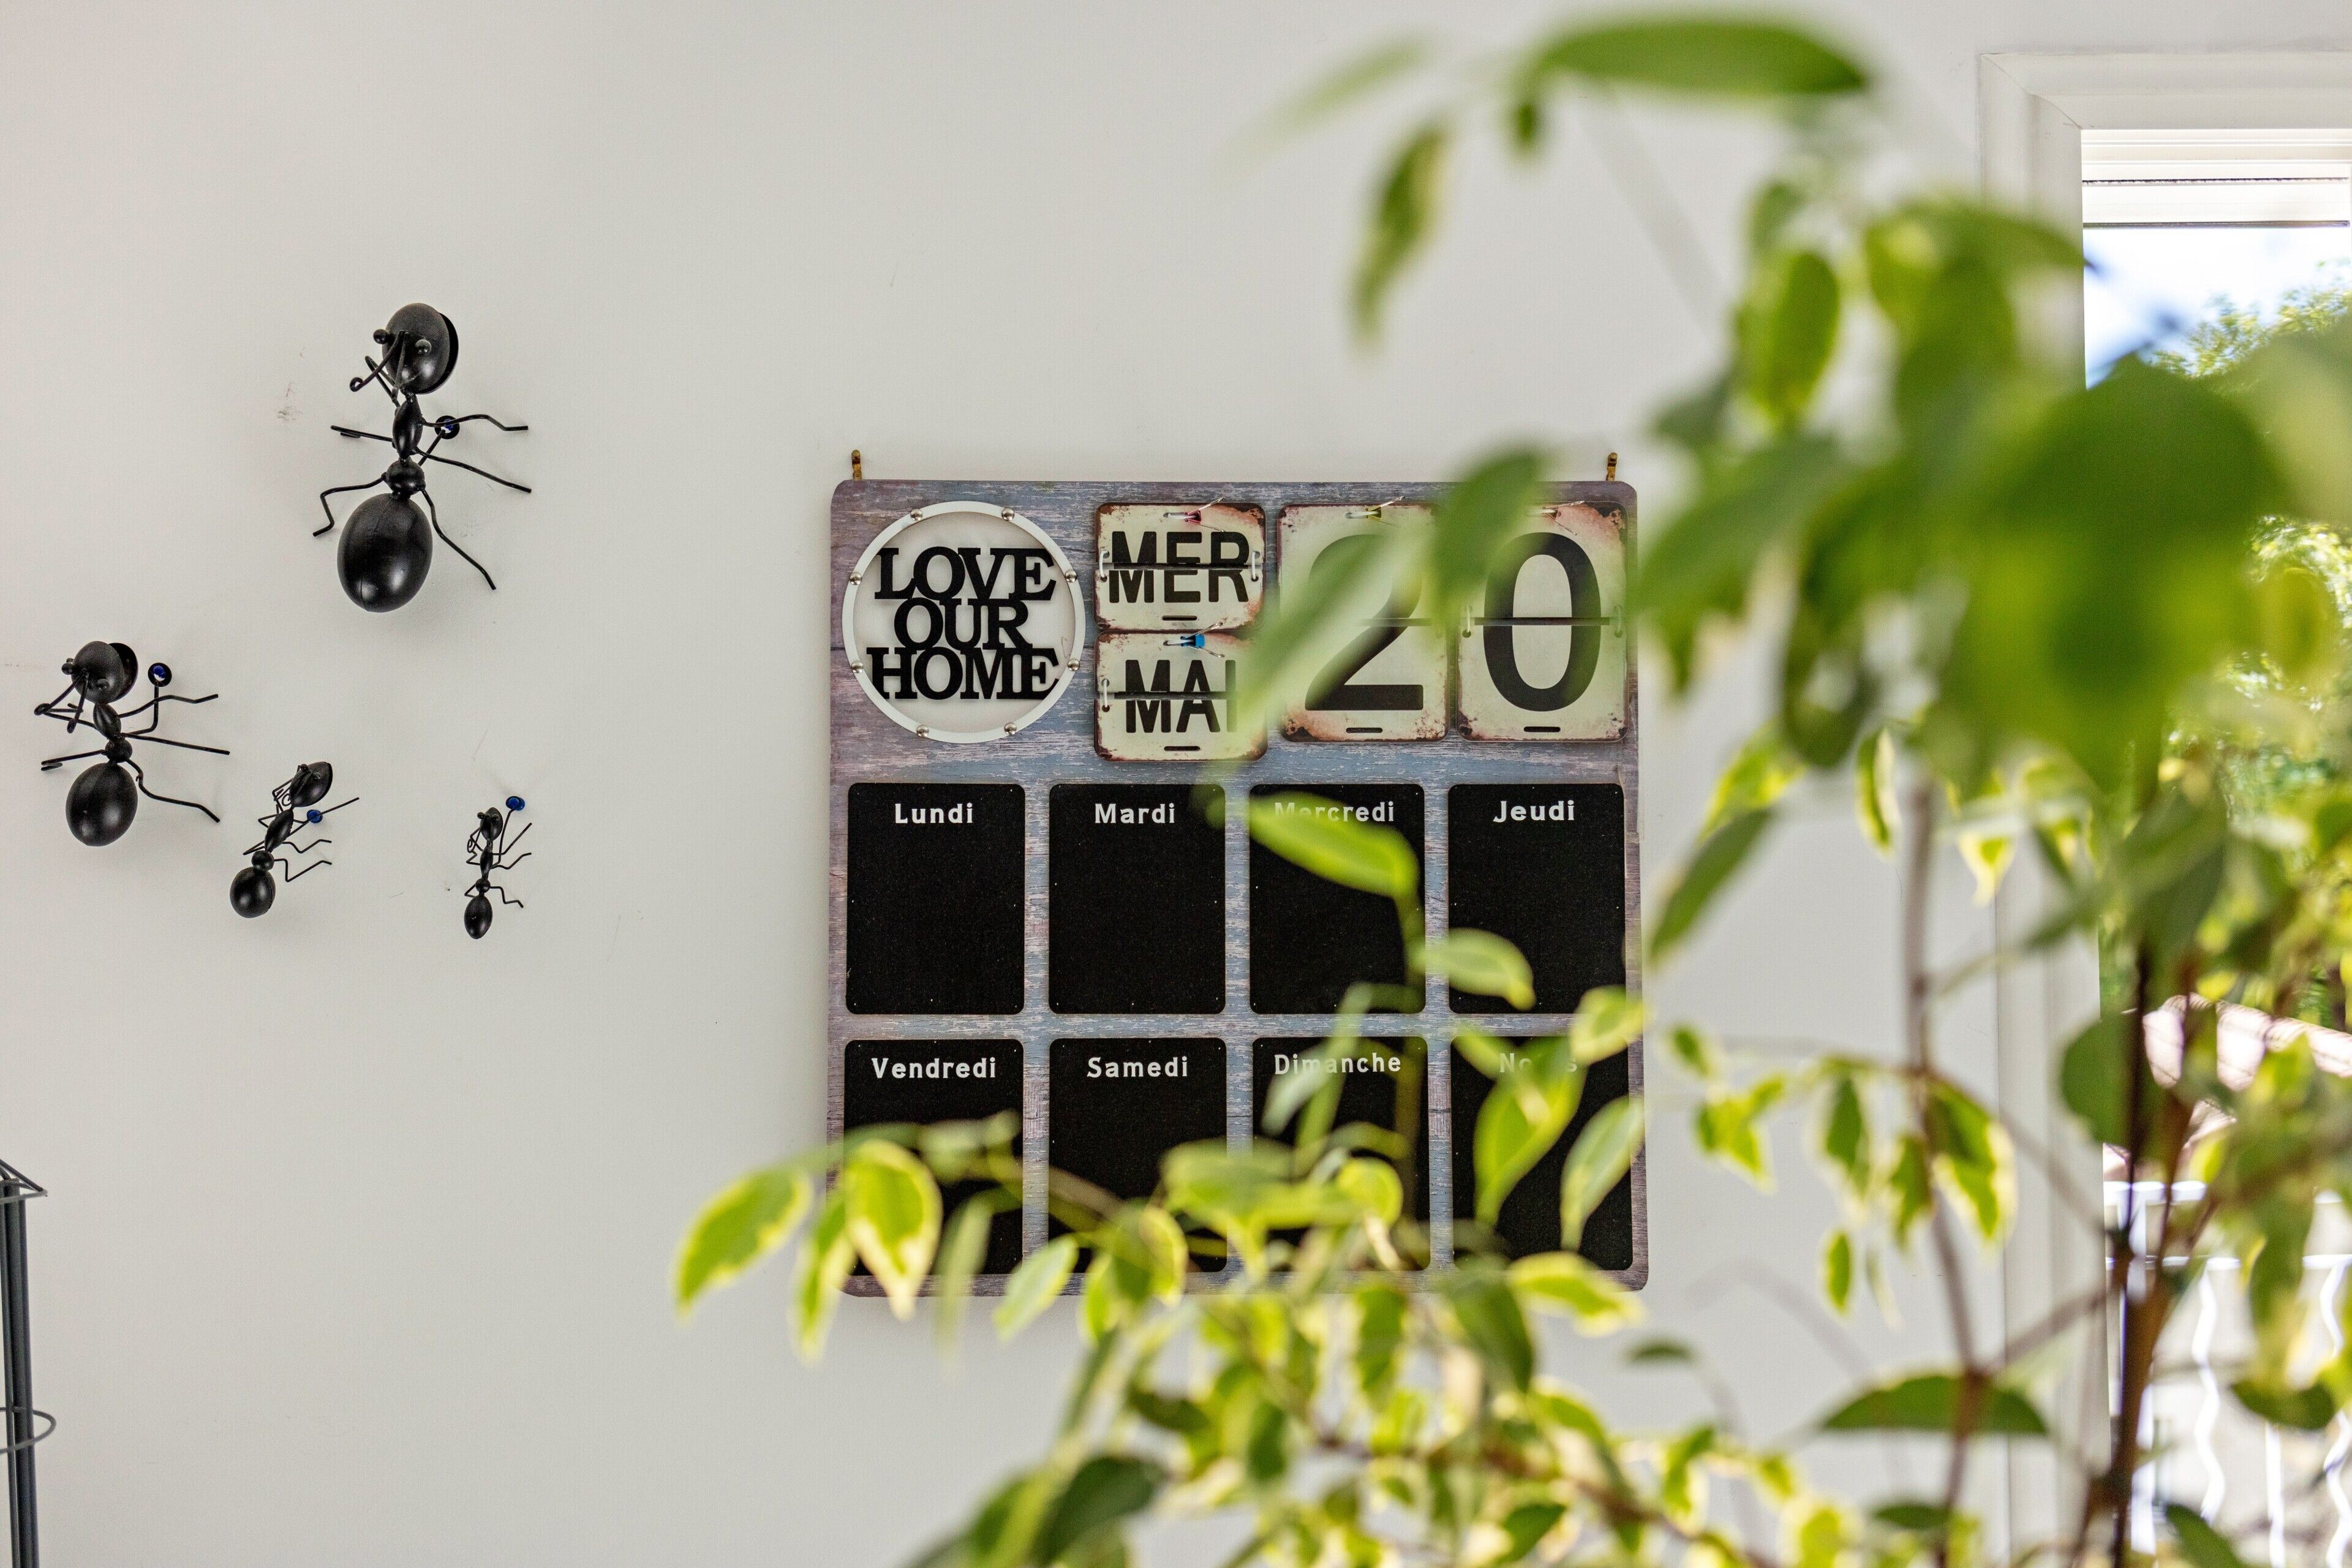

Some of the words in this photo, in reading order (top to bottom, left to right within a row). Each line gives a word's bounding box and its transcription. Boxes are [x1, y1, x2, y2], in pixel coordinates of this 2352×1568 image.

[875, 546, 1057, 600] LOVE
[1108, 531, 1250, 603] MER
[894, 597, 1033, 650] OUR
[866, 647, 1059, 699] HOME
[1126, 660, 1237, 733] MAI
[894, 802, 973, 824] Lundi
[1095, 802, 1175, 824] Mardi
[1493, 799, 1575, 821] Jeudi
[872, 1057, 996, 1079] Vendredi
[1087, 1055, 1188, 1078] Samedi
[1499, 1052, 1577, 1072] Nos
